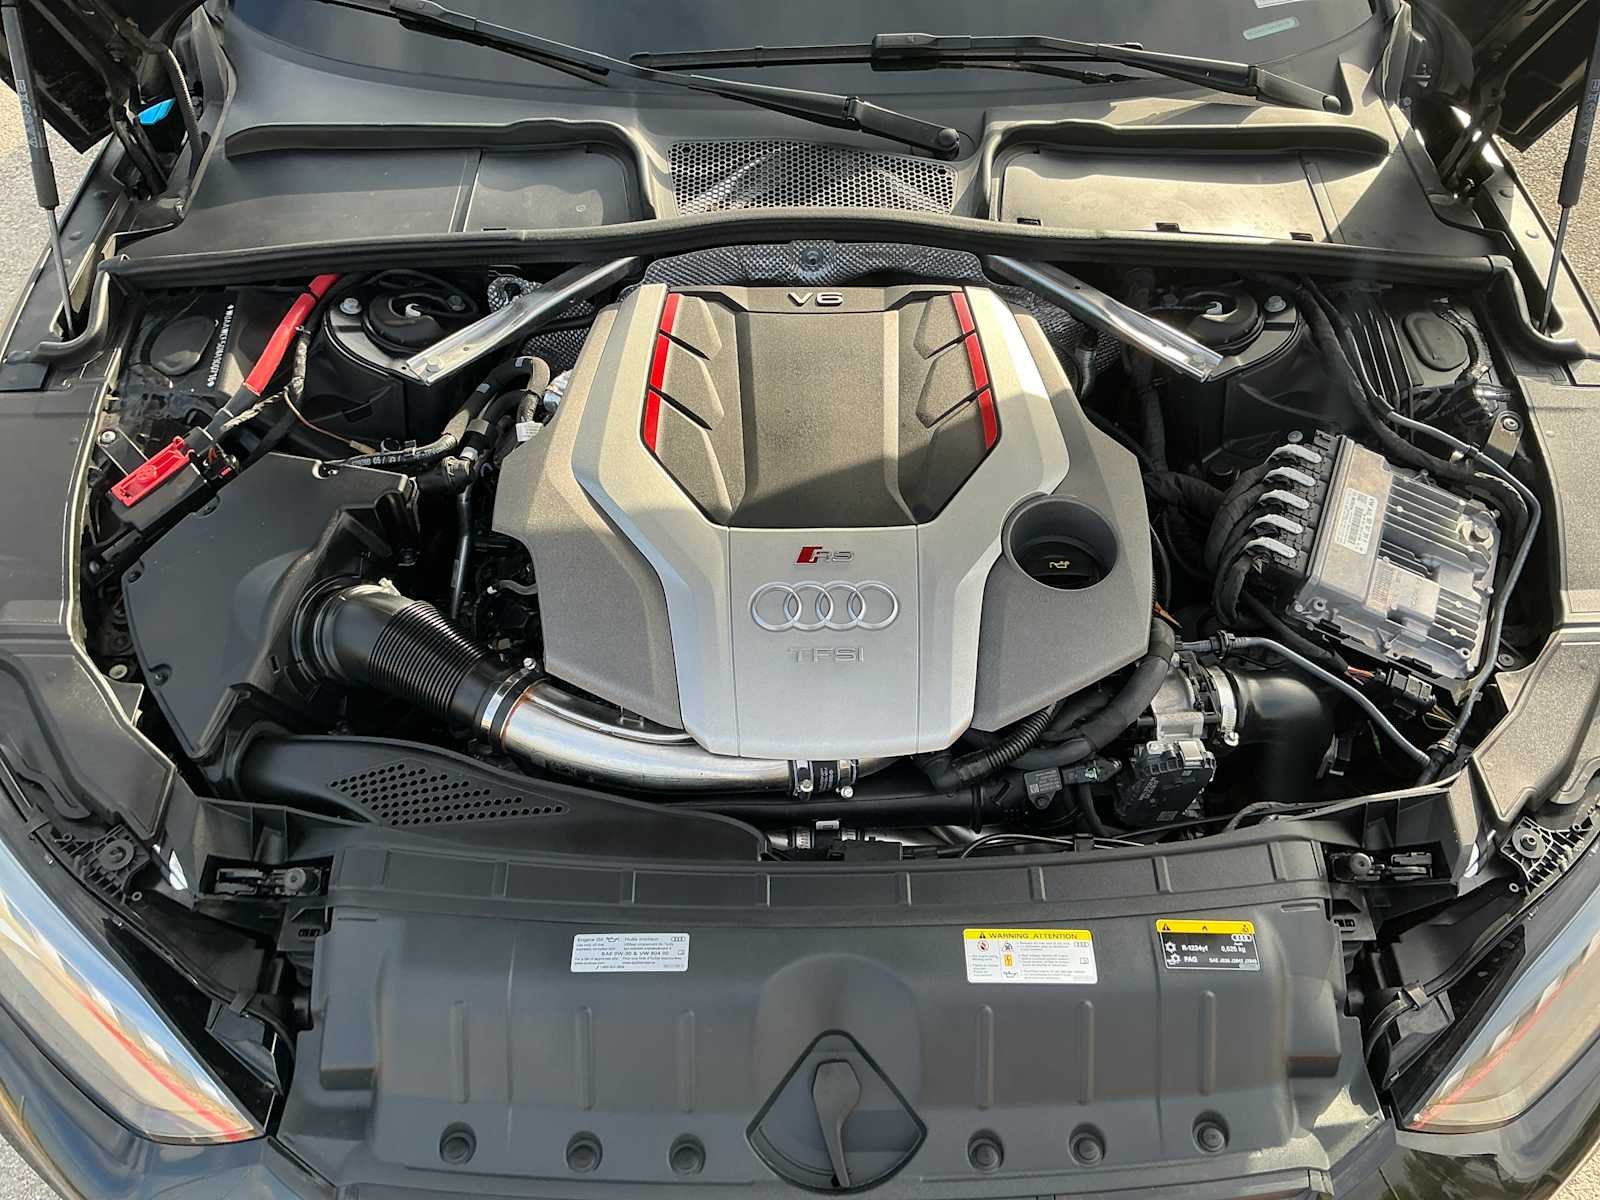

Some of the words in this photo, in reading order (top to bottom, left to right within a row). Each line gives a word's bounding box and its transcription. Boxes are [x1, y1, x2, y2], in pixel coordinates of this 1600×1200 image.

[787, 292, 844, 307] V6
[797, 546, 855, 563] RS
[788, 648, 865, 663] TFSI
[989, 932, 1029, 940] WARNING
